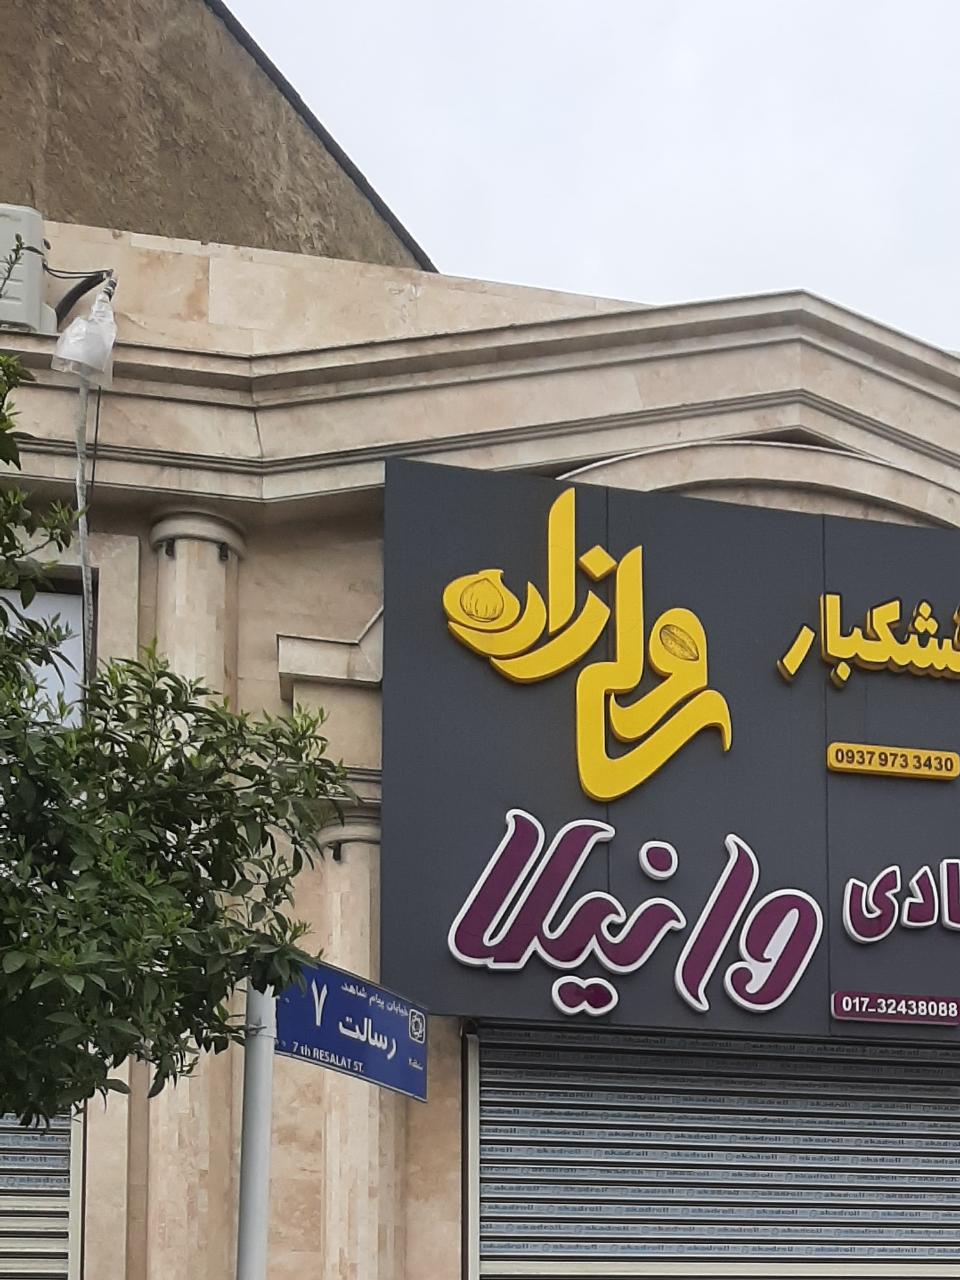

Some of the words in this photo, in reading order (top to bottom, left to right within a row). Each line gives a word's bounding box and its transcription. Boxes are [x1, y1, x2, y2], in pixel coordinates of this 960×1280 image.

[835, 747, 875, 767] 0937
[878, 751, 909, 769] 973
[912, 754, 954, 773] 3430
[339, 1016, 397, 1060] رسالت
[292, 1041, 298, 1052] 7
[300, 1042, 311, 1057] th
[313, 1048, 352, 1069] RESALAT
